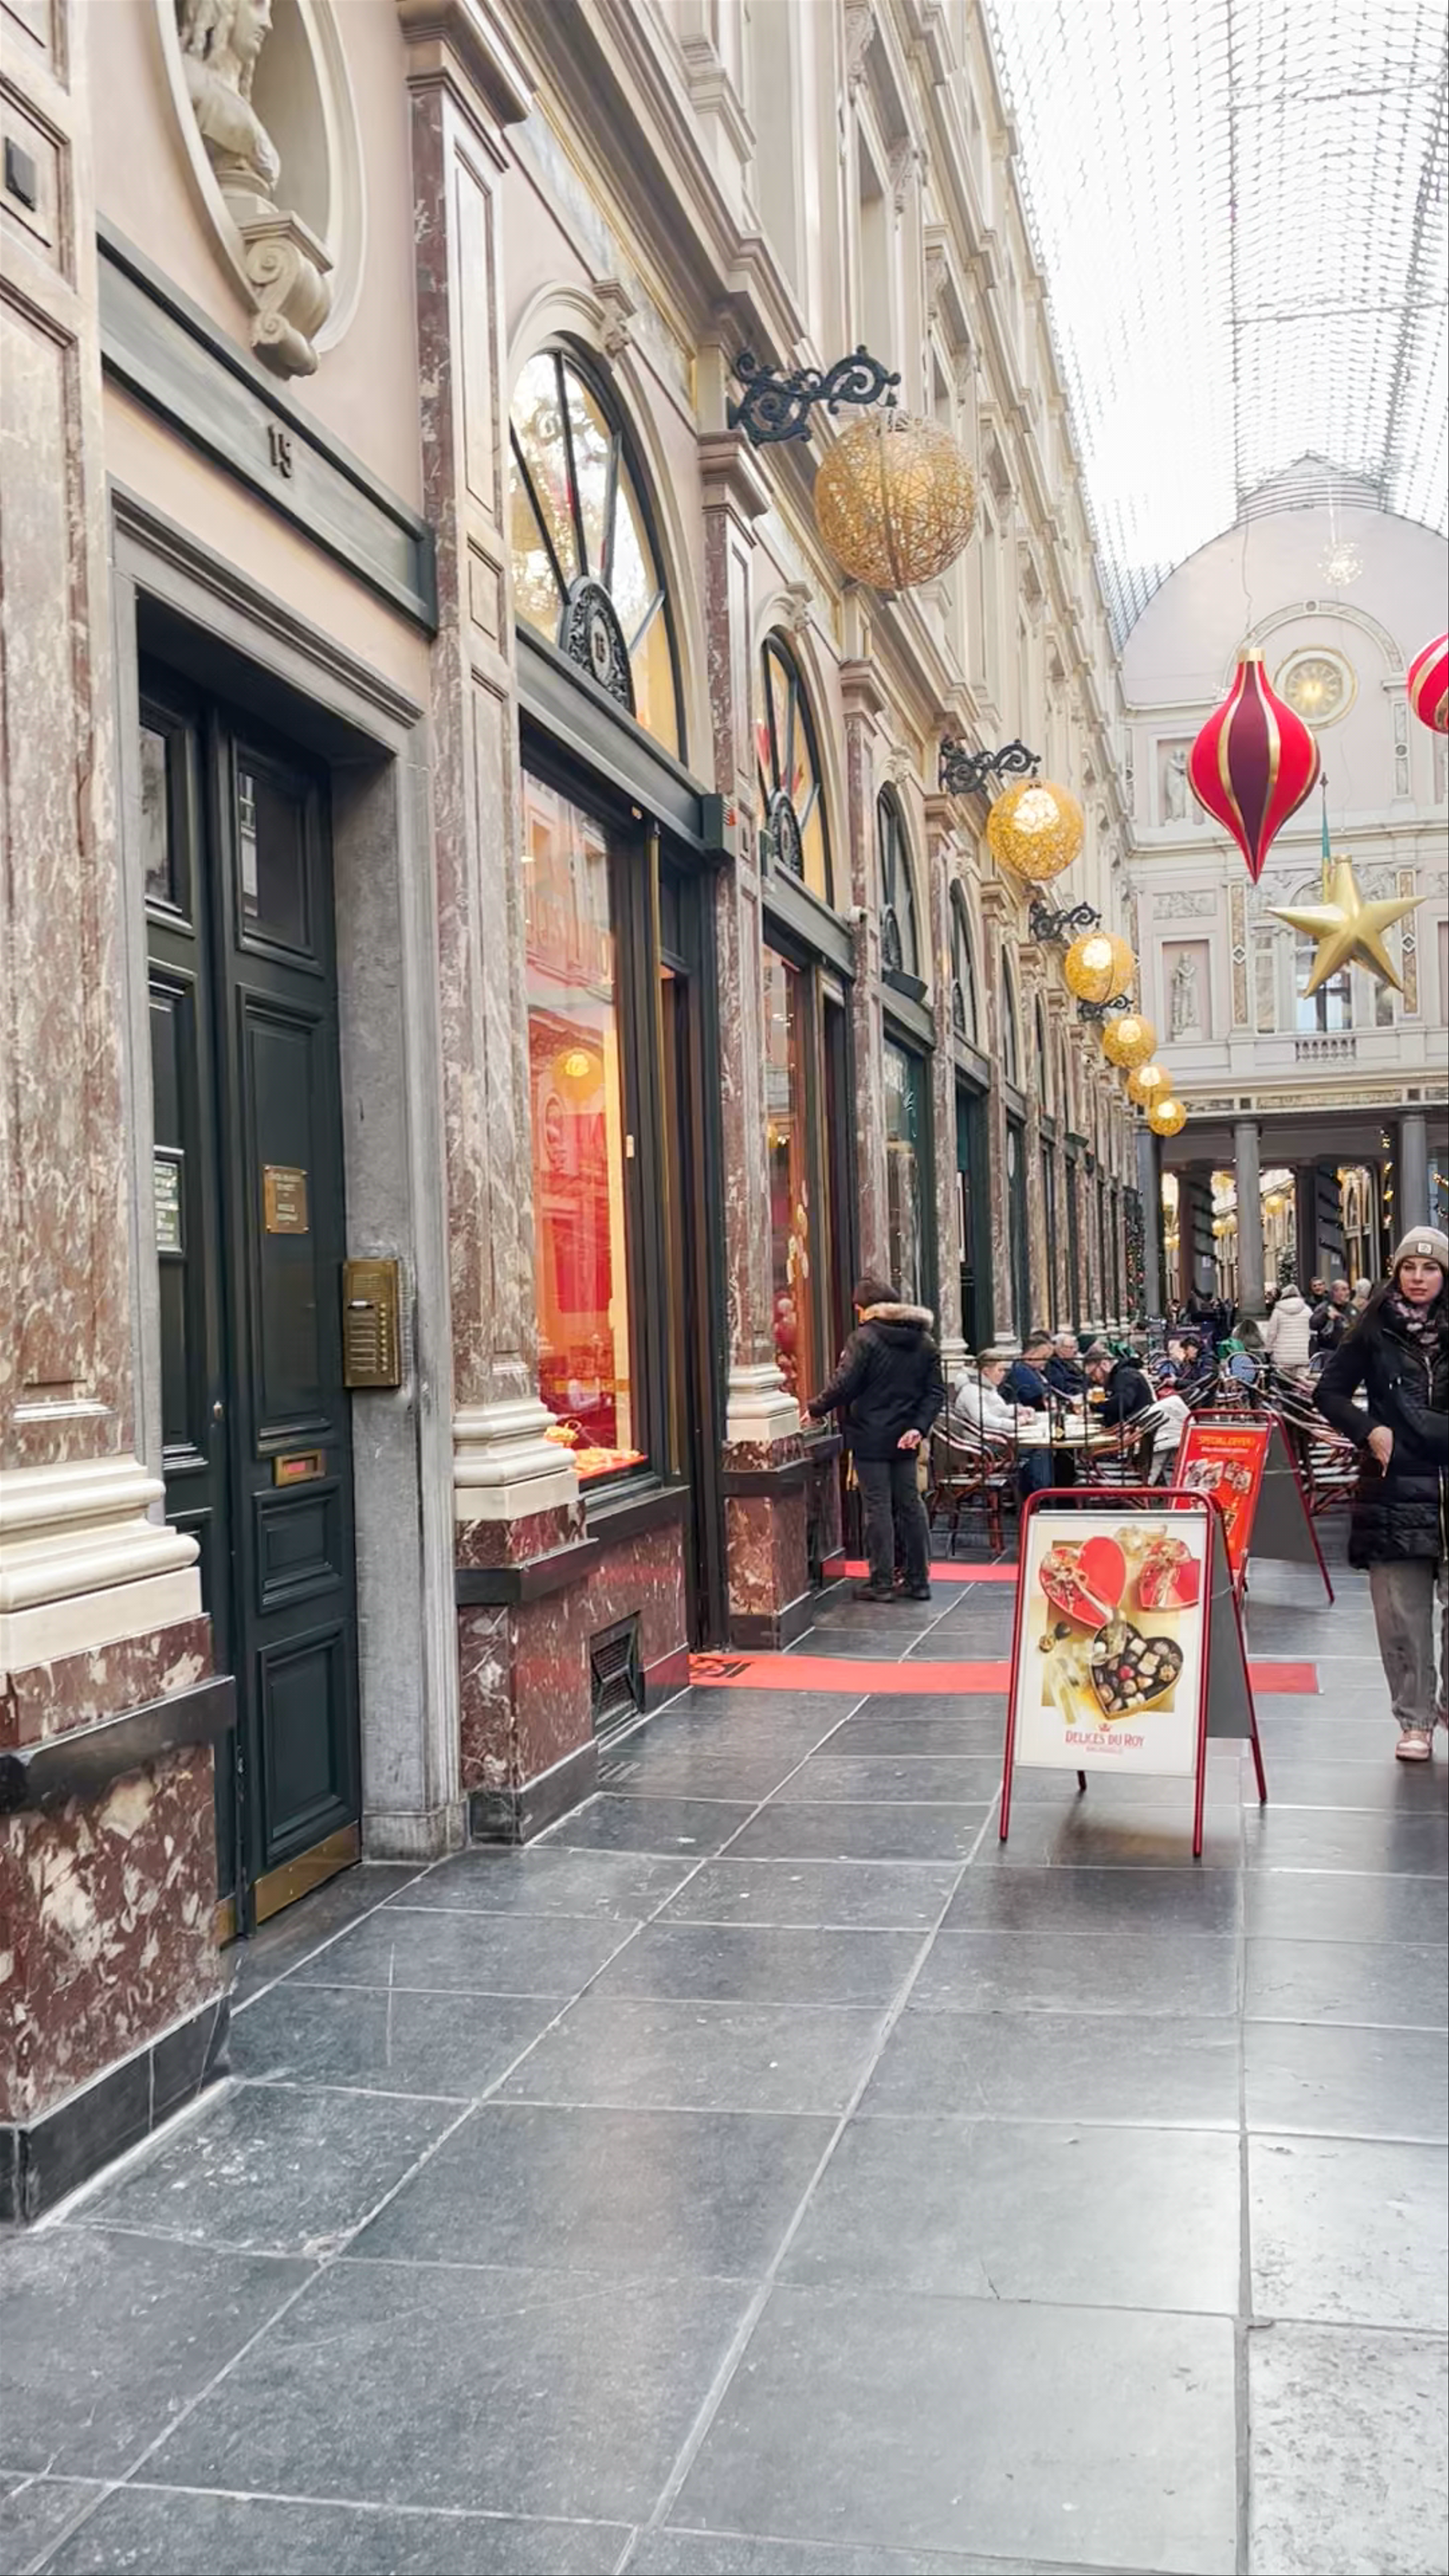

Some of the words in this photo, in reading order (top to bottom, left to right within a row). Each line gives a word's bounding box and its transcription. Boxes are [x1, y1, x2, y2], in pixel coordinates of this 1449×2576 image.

[268, 424, 292, 478] 15
[1065, 1730, 1105, 1744] DELICES
[1108, 1734, 1122, 1745] DU
[1124, 1734, 1145, 1747] ROY
